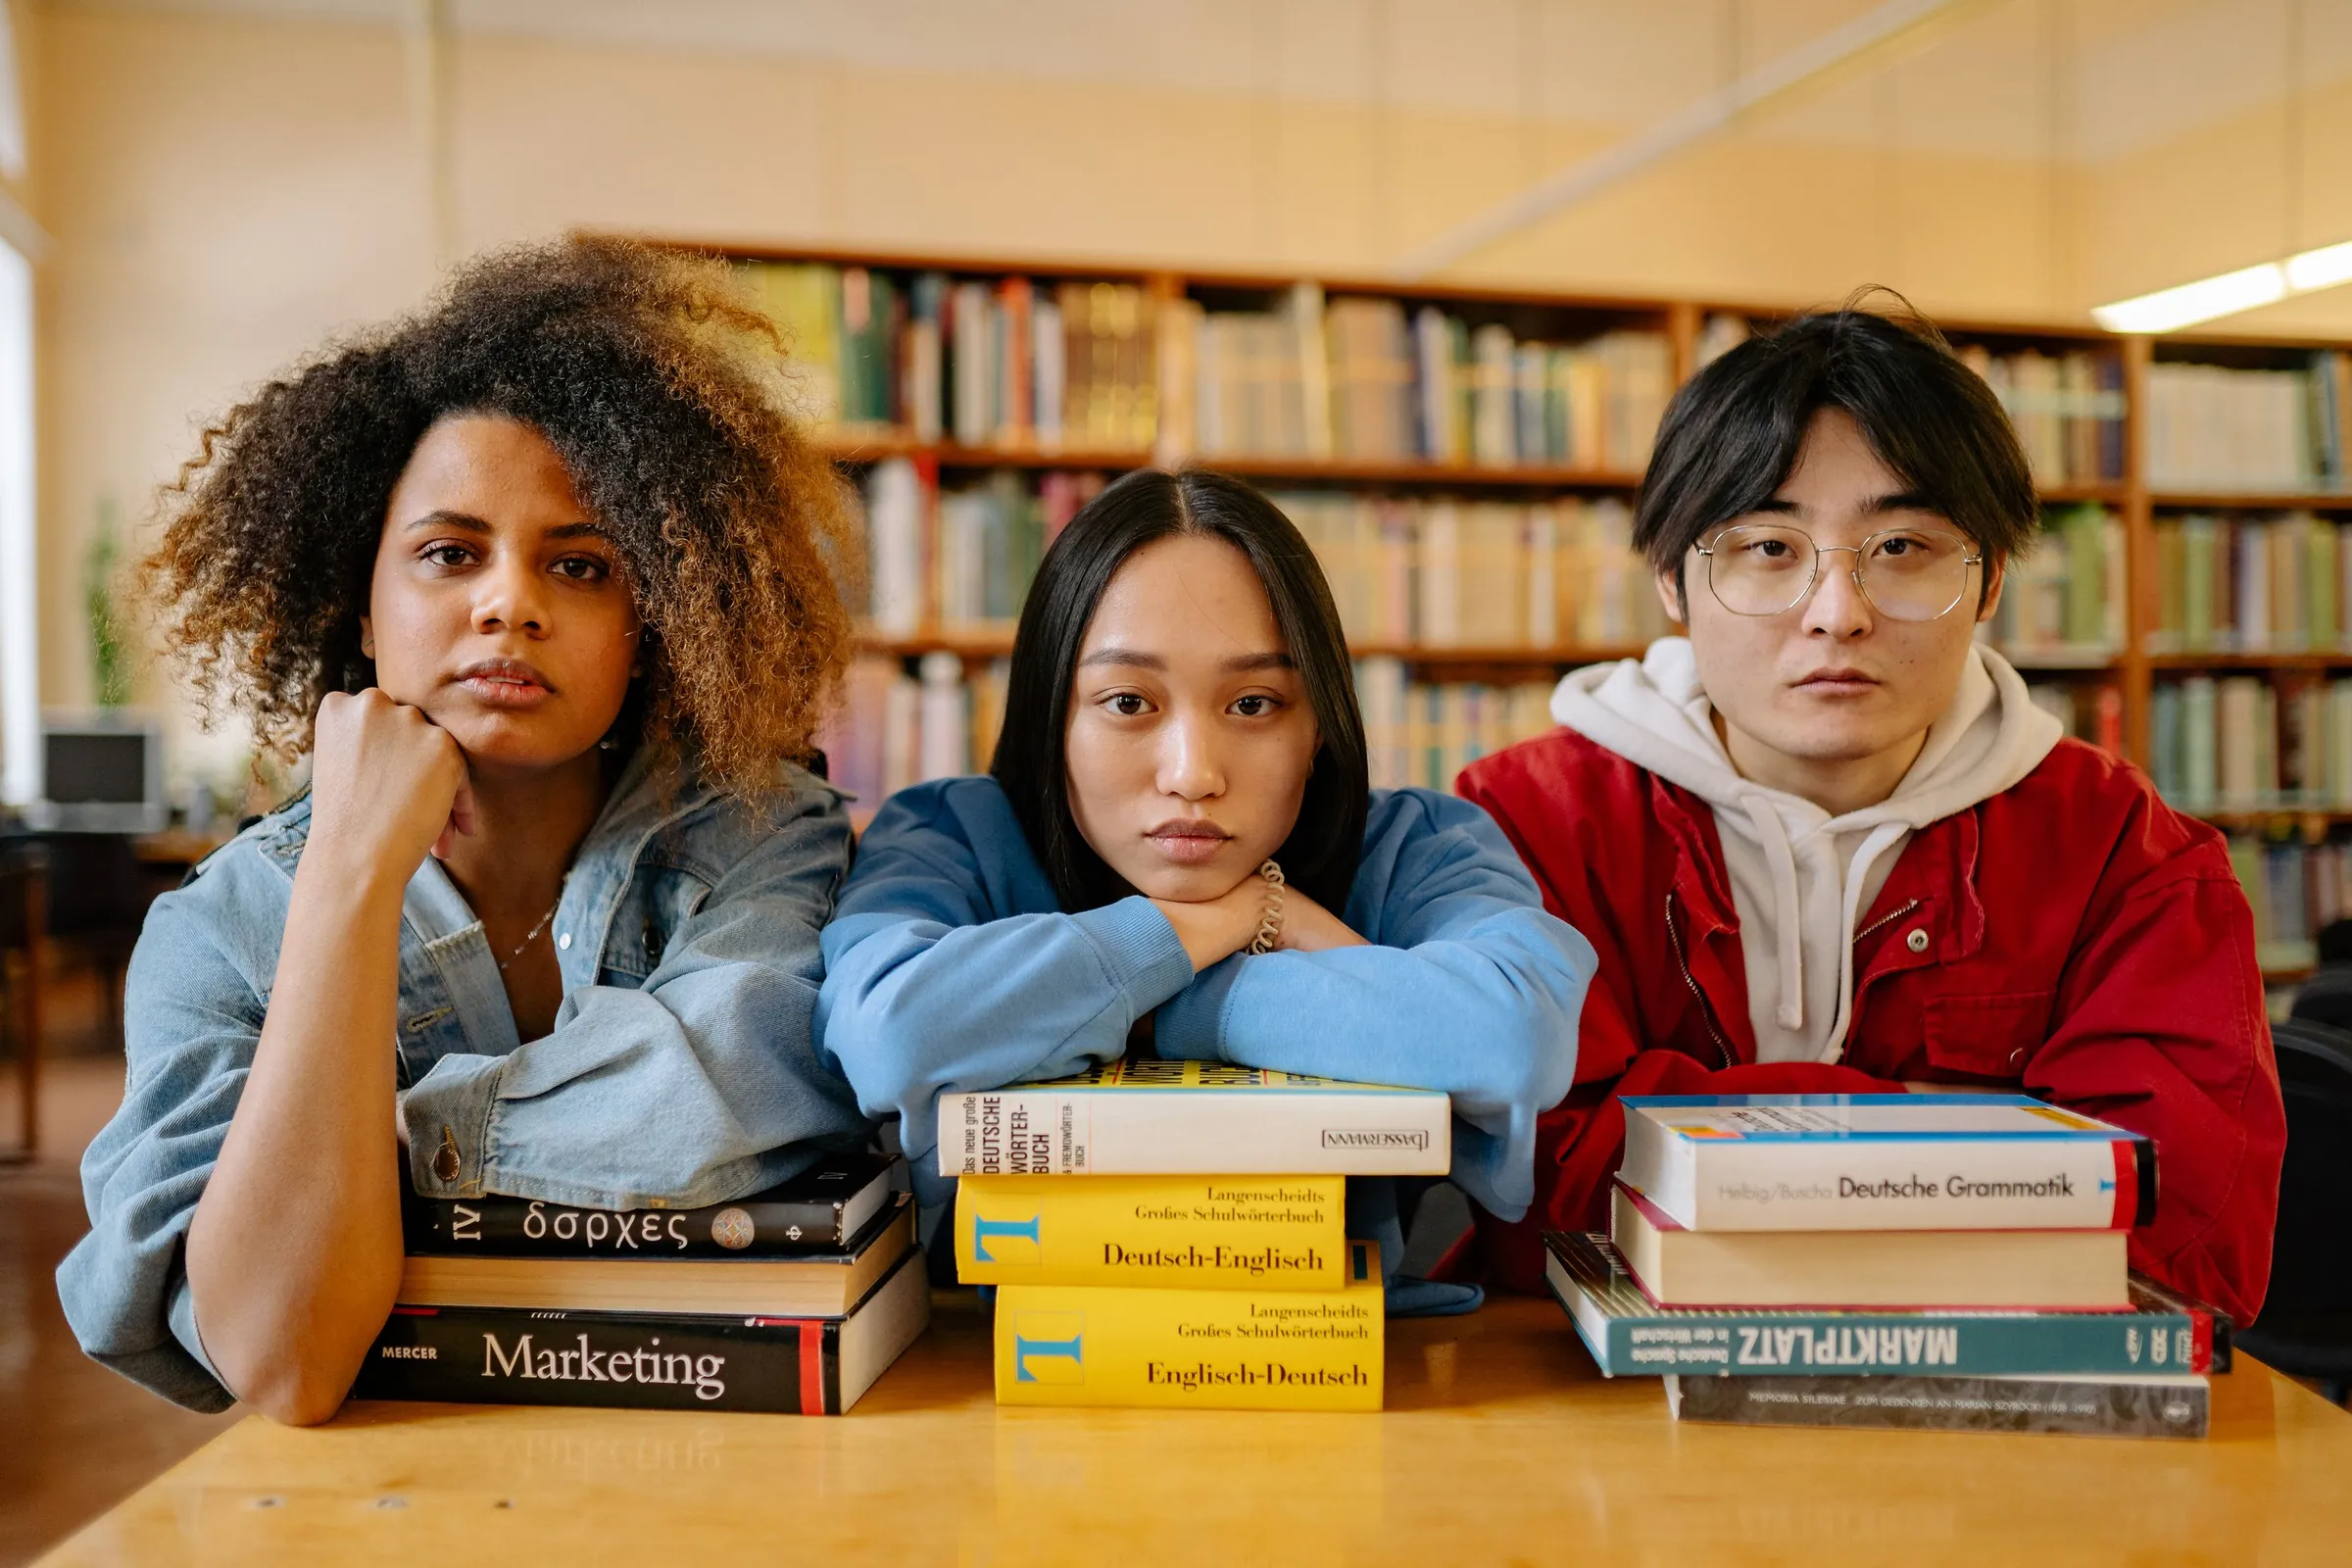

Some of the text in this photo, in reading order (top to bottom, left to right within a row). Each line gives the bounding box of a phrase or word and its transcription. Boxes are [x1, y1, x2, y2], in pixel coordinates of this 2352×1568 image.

[962, 1097, 978, 1175] Das neue große
[983, 1097, 1001, 1175] DEUTSCHE
[1005, 1104, 1028, 1175] WÖRTER-
[1032, 1134, 1050, 1175] BUCH
[1075, 1145, 1085, 1167] BUCH
[1207, 1187, 1325, 1205] Langenscheidts
[1838, 1175, 1938, 1200] Deutsche
[1947, 1174, 2074, 1199] Grammatik
[1135, 1205, 1325, 1224] Großes Schulwörterbuch
[1103, 1243, 1324, 1277] Deutsch-Englisch
[1250, 1303, 1369, 1322] Langenscheidts
[1178, 1324, 1369, 1341] Großes Schulwörterbuch
[1737, 1327, 1958, 1365] MARKTPLATZ
[381, 1347, 438, 1360] MERCER
[481, 1333, 726, 1400] Marketing
[1148, 1362, 1368, 1393] Englisch-Deutsch
[1749, 1392, 1800, 1404] MEMORIA
[1802, 1394, 1846, 1405] SILESIAE
[1855, 1396, 1878, 1407] ZUM
[1881, 1397, 1935, 1409] GEDENKEN
[1936, 1398, 1952, 1409] AN
[1954, 1399, 1992, 1411] MARIAN
